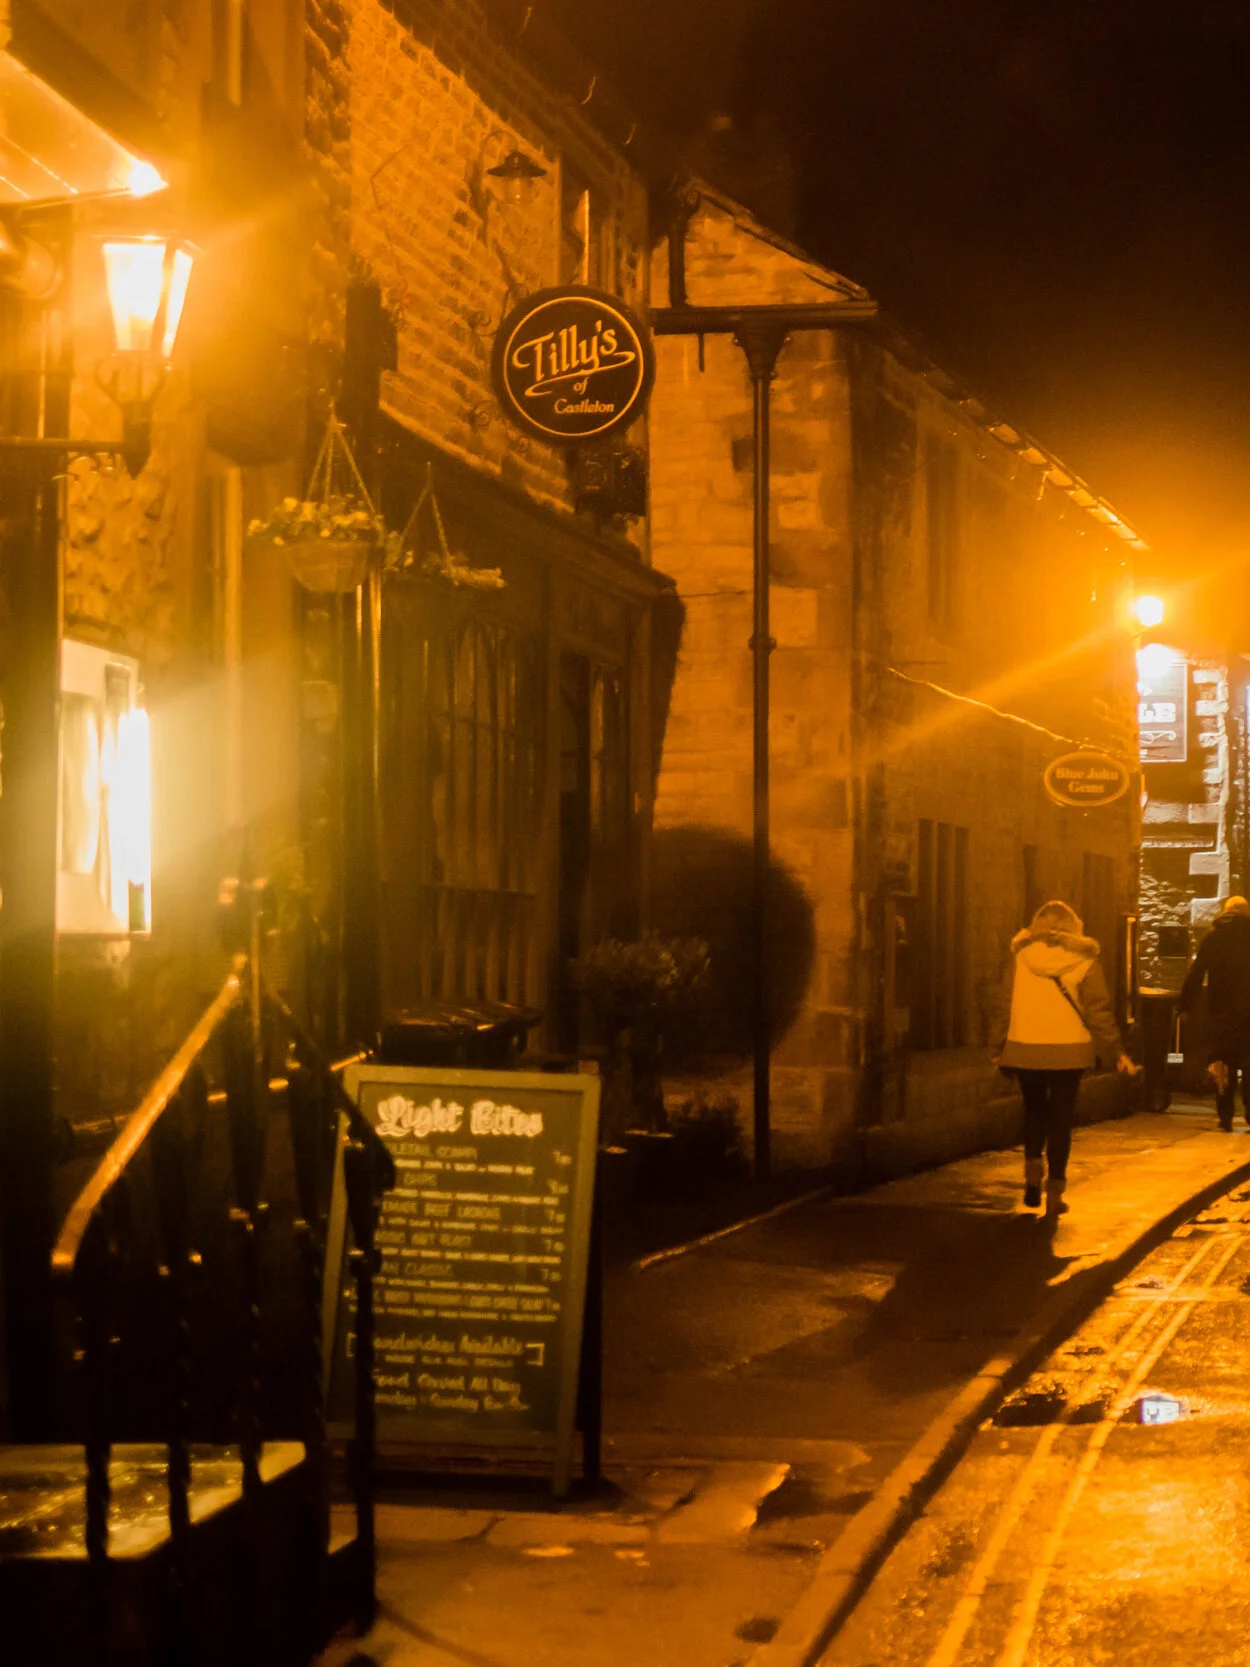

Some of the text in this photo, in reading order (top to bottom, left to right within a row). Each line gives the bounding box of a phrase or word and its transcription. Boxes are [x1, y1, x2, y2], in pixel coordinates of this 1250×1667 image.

[512, 320, 635, 394] Tilly's
[573, 377, 590, 395] of
[554, 398, 614, 414] Castleton
[1056, 768, 1119, 781] Blue John
[1068, 781, 1105, 793] Gems
[375, 1094, 543, 1137] Light Bites
